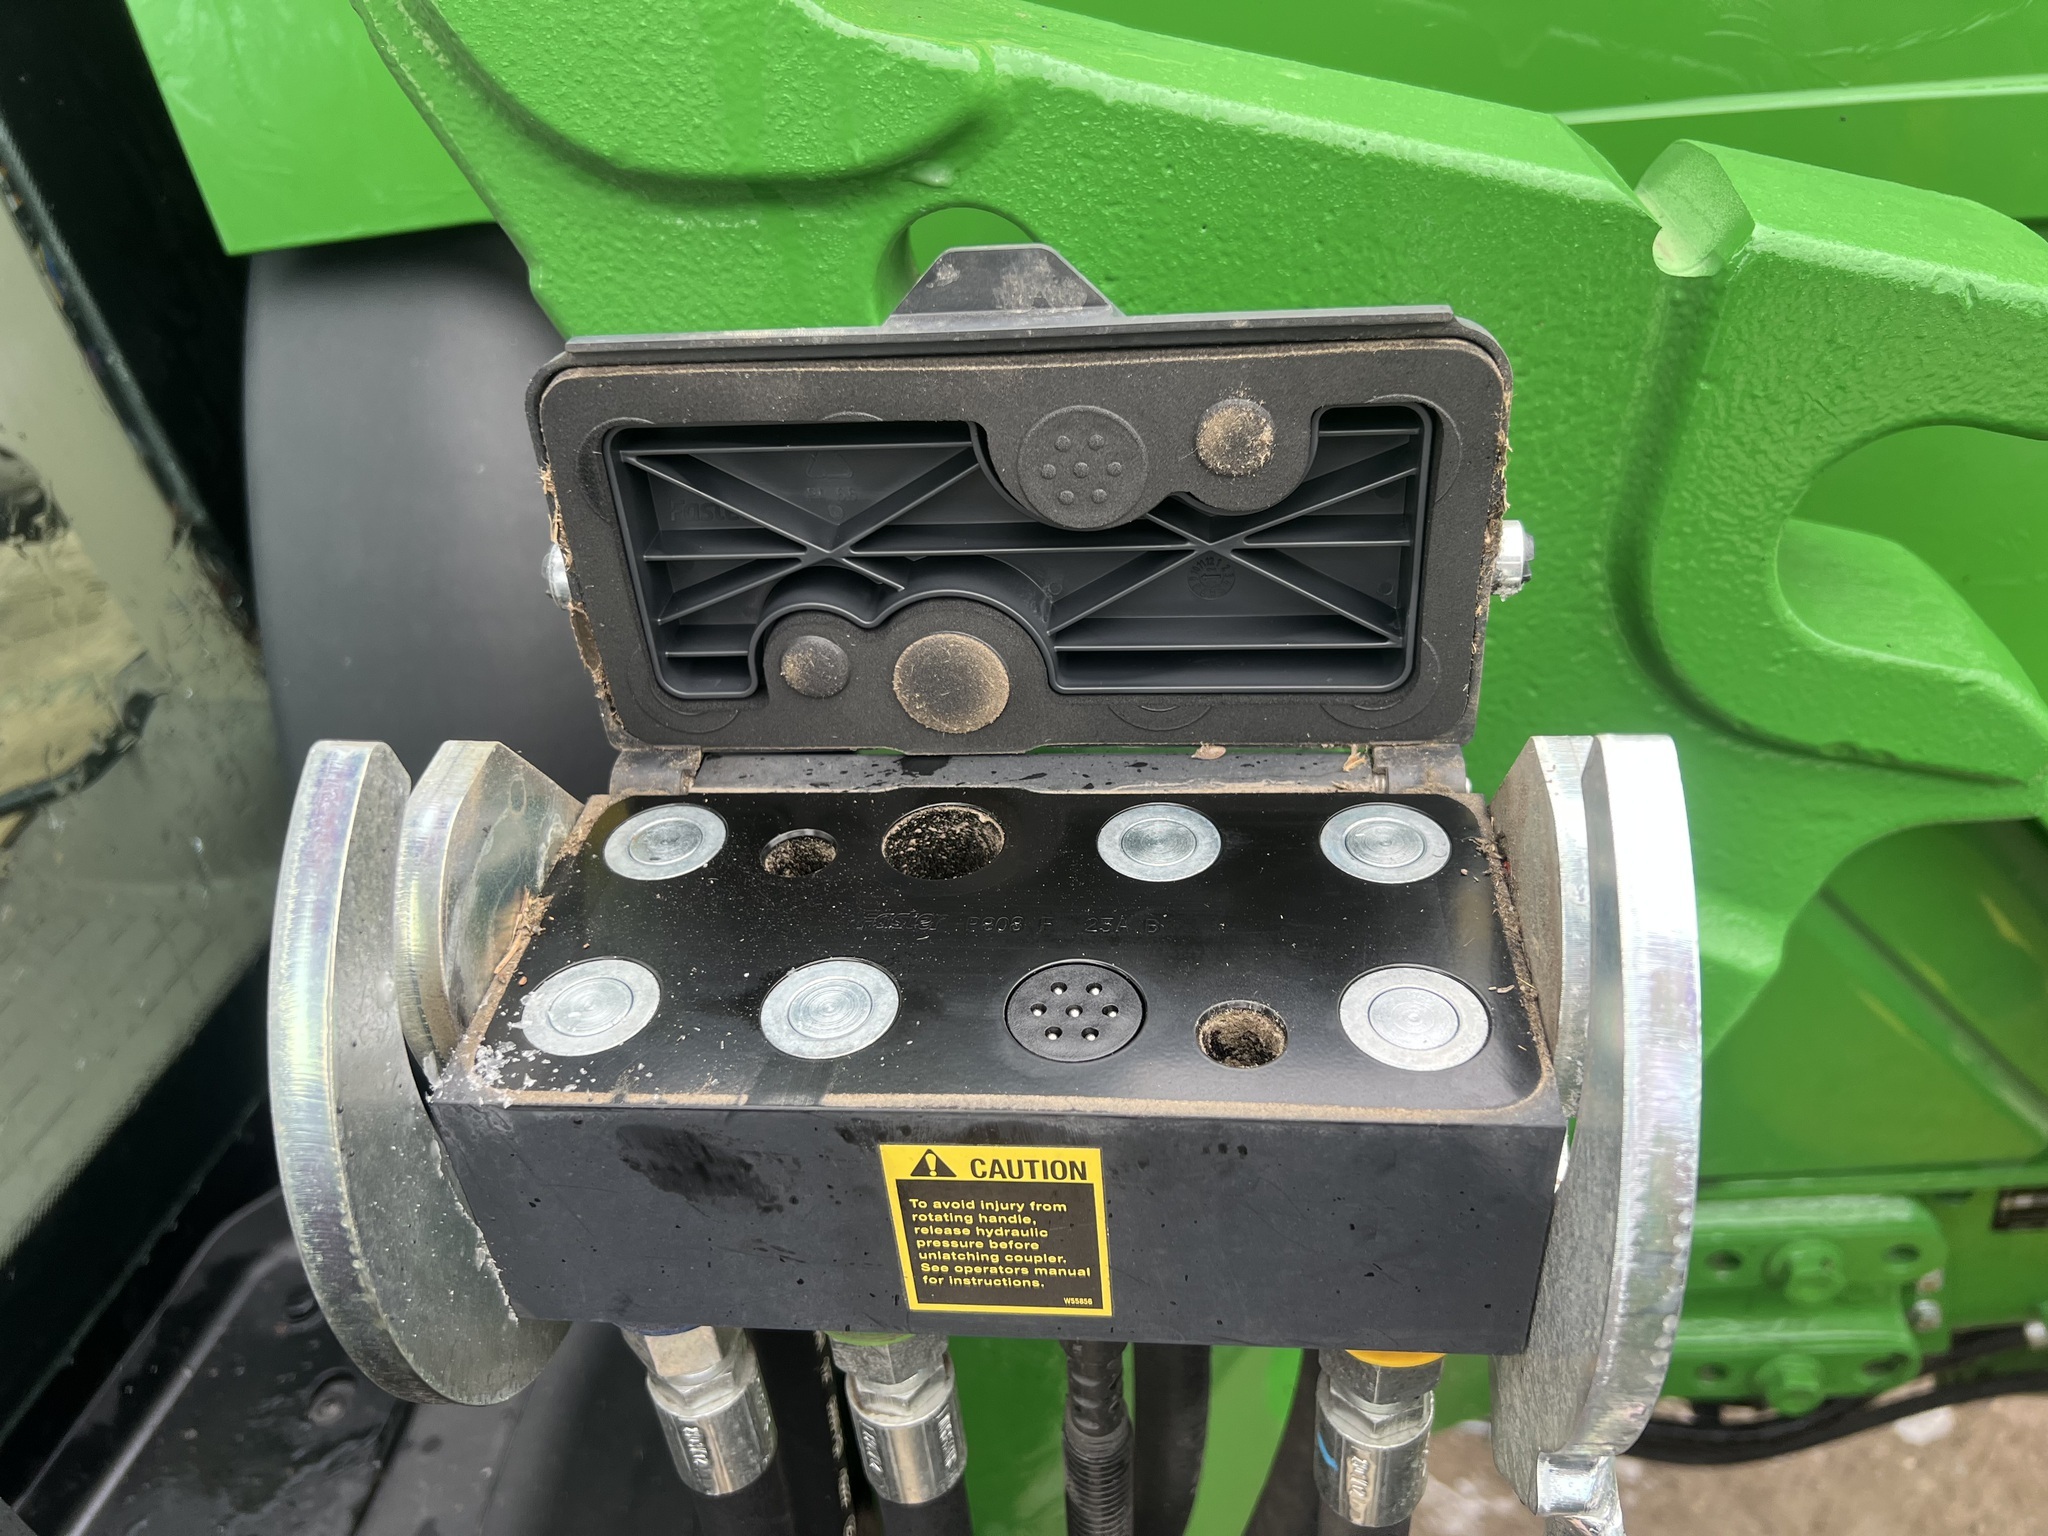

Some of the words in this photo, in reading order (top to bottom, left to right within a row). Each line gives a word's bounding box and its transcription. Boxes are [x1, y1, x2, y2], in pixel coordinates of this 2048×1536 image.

[969, 1158, 1088, 1180] CAUTION
[909, 1198, 927, 1209] To
[932, 1199, 975, 1210] avoid
[980, 1199, 1025, 1212] injury
[1029, 1201, 1067, 1212] from
[911, 1212, 973, 1225] rotating
[978, 1213, 1037, 1225] handle,
[914, 1225, 971, 1236] release
[976, 1226, 1048, 1238] hydraulic
[916, 1238, 984, 1250] pressure
[988, 1239, 1040, 1250] before
[918, 1250, 1000, 1263] unlatching
[1004, 1253, 1067, 1265] coupler.
[920, 1262, 949, 1273] See
[954, 1265, 1029, 1277] operators
[1033, 1266, 1091, 1278] manual
[922, 1274, 944, 1285] for
[949, 1275, 1045, 1288] instructions.
